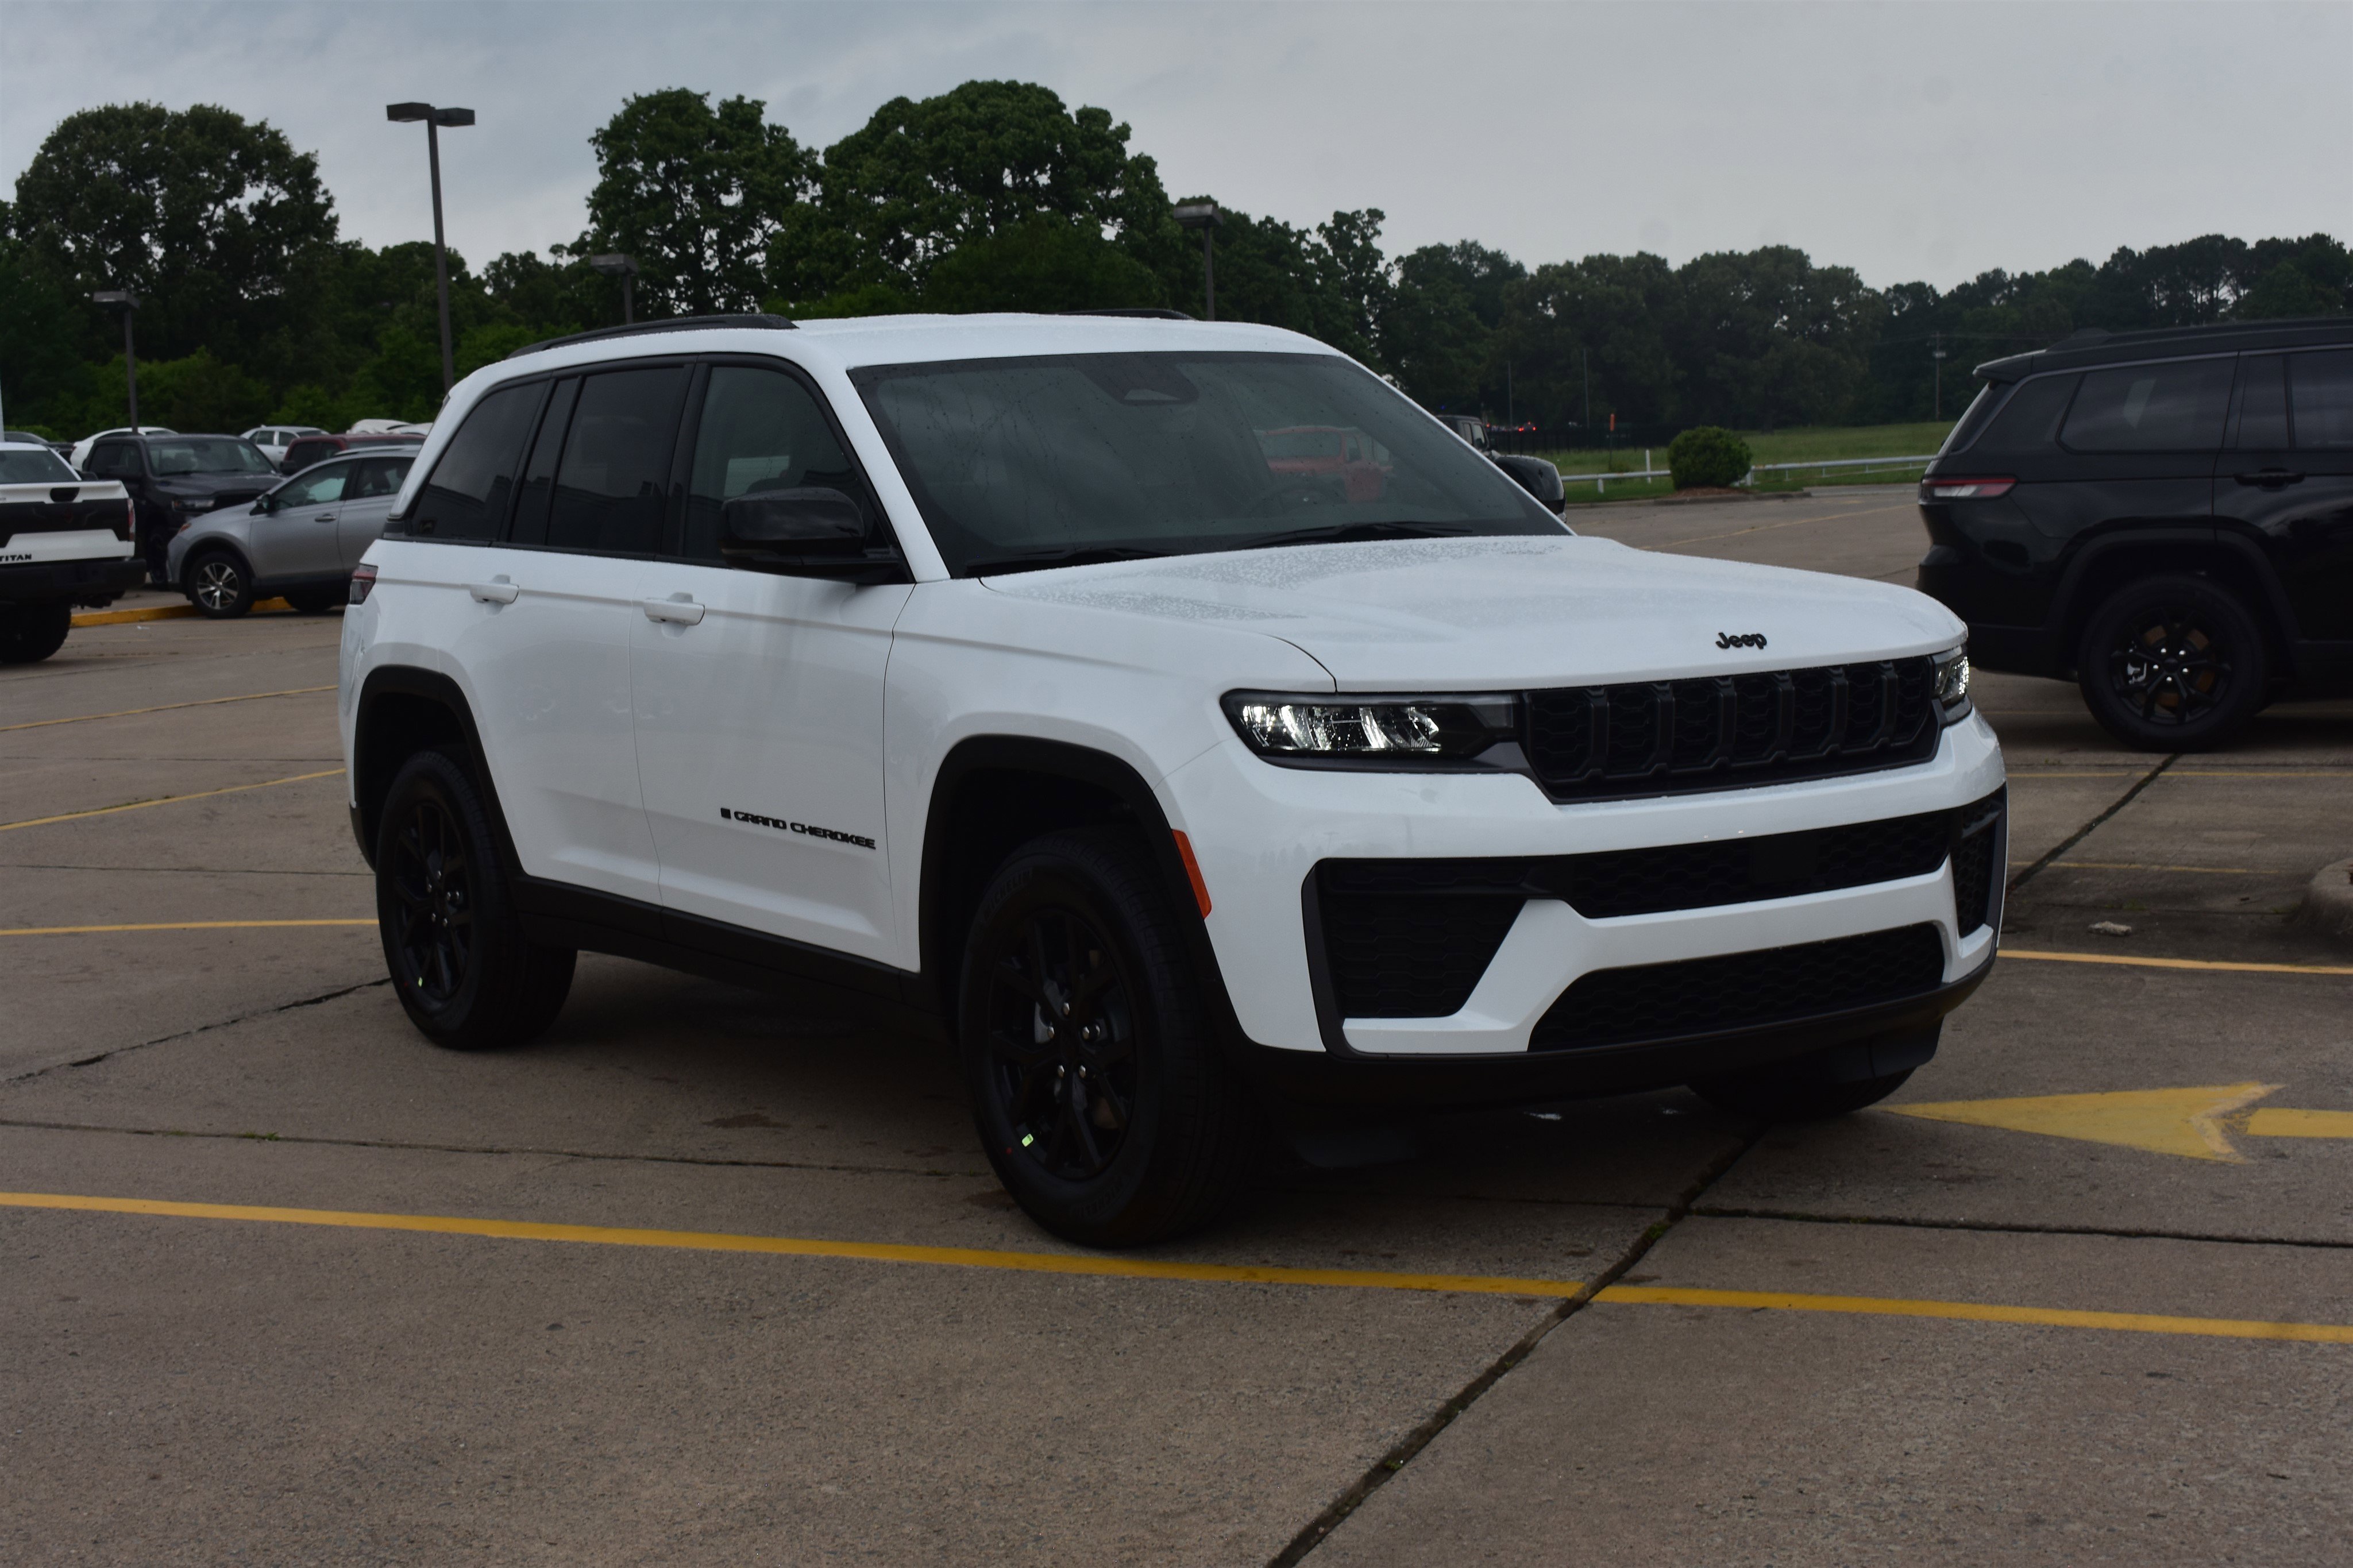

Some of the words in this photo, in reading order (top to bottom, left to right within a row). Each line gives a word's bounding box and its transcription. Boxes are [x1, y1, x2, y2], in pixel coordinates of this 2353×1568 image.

[1715, 632, 1767, 649] Jeep
[734, 811, 787, 830] GRAND
[790, 822, 876, 849] CHEROKEE
[983, 868, 1033, 922] MICHELIN
